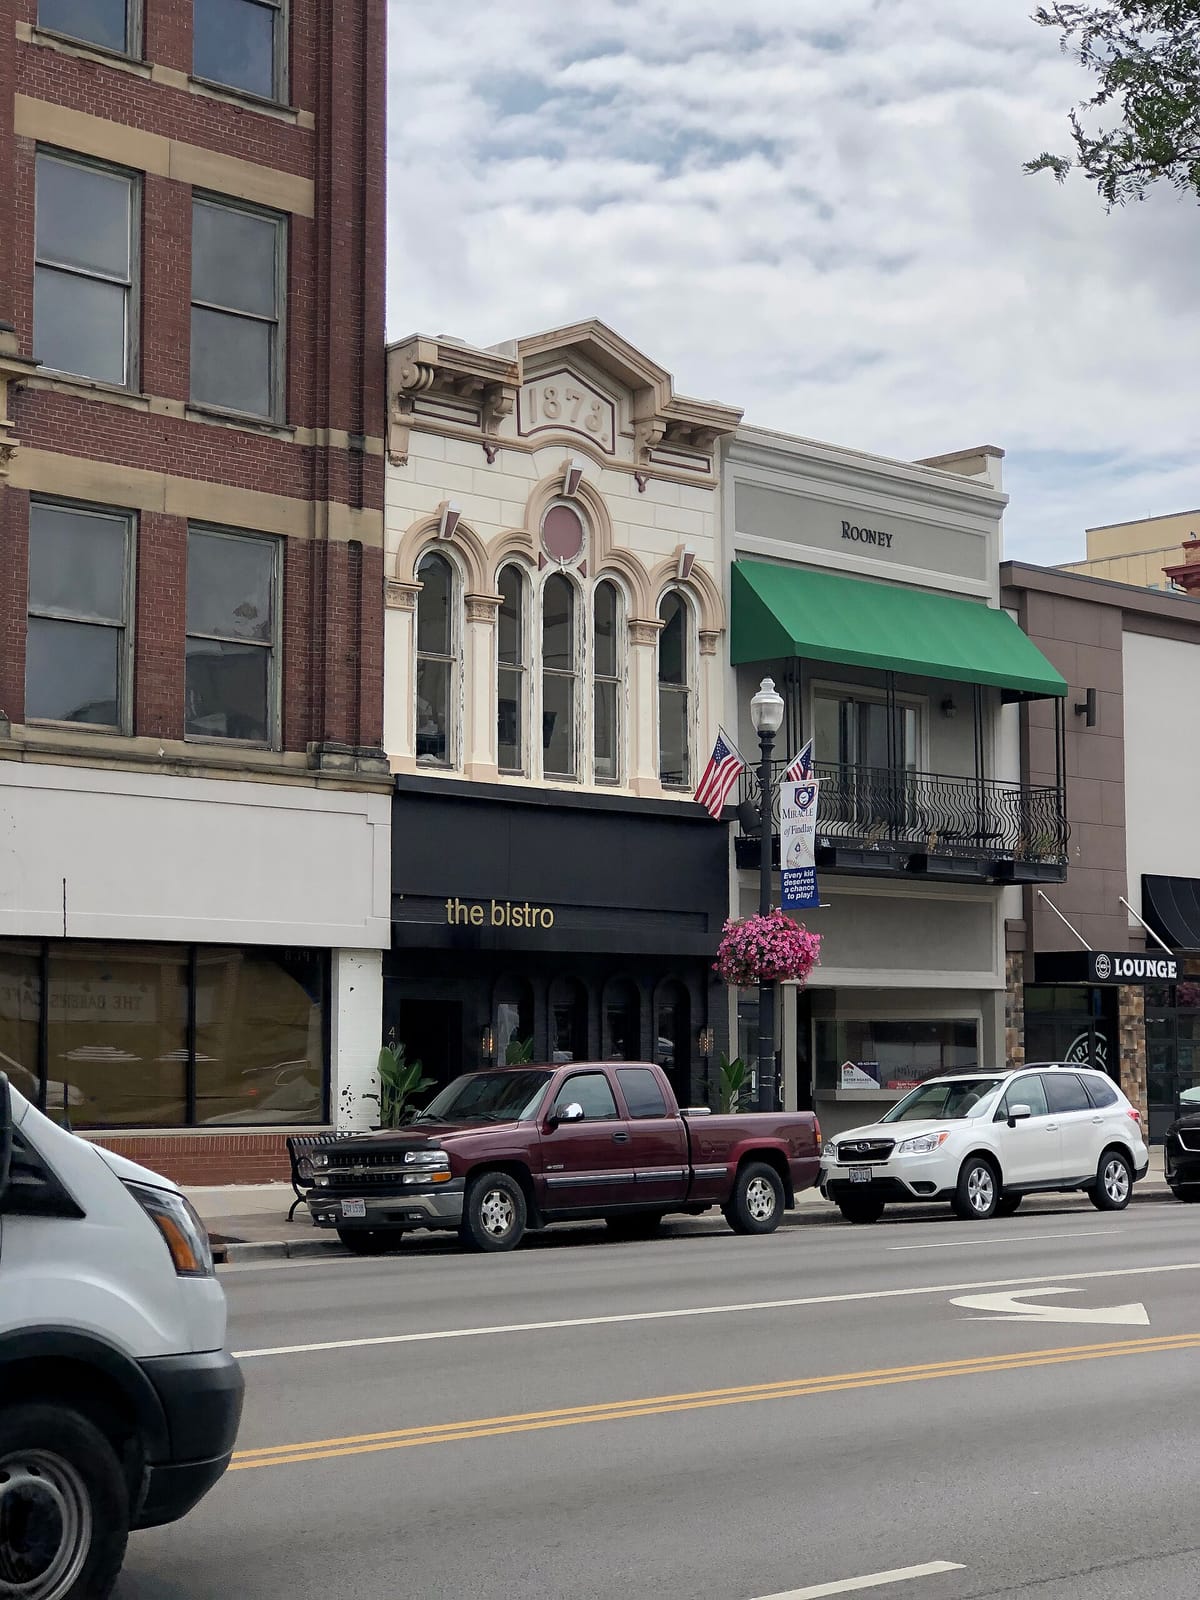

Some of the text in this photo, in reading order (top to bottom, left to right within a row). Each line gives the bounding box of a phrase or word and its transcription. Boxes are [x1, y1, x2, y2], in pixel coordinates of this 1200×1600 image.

[782, 808, 814, 819] MIRACLE
[784, 824, 813, 837] of Findlay
[784, 869, 814, 880] Every kid
[783, 878, 814, 886] deserves
[795, 891, 813, 900] play!
[445, 898, 554, 928] the bistro
[1113, 958, 1177, 979] LOUNGE
[1070, 1041, 1107, 1063] IRTAL
